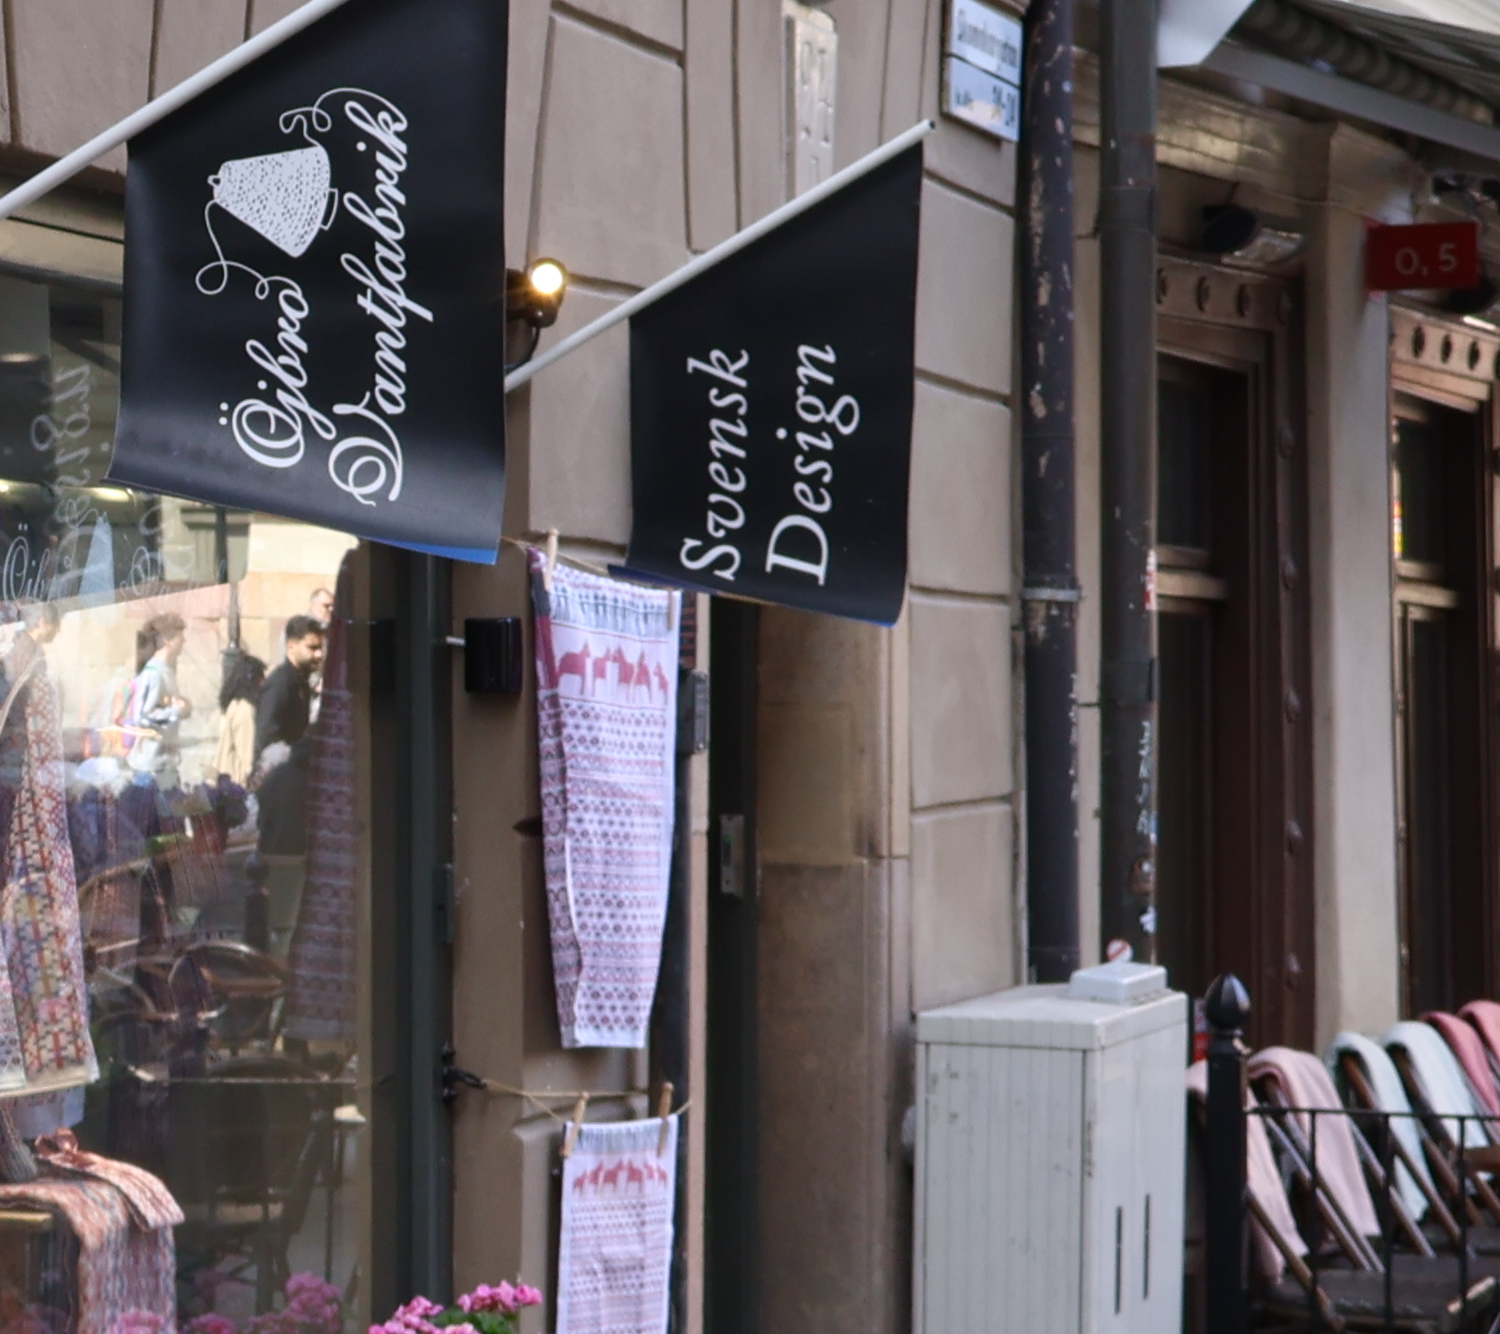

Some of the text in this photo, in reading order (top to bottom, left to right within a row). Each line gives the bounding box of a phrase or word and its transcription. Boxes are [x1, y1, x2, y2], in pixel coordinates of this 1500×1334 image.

[219, 287, 337, 468] Öjbro
[328, 100, 434, 506] Vantfabrik
[679, 348, 750, 581] Svensk
[765, 344, 860, 586] Design
